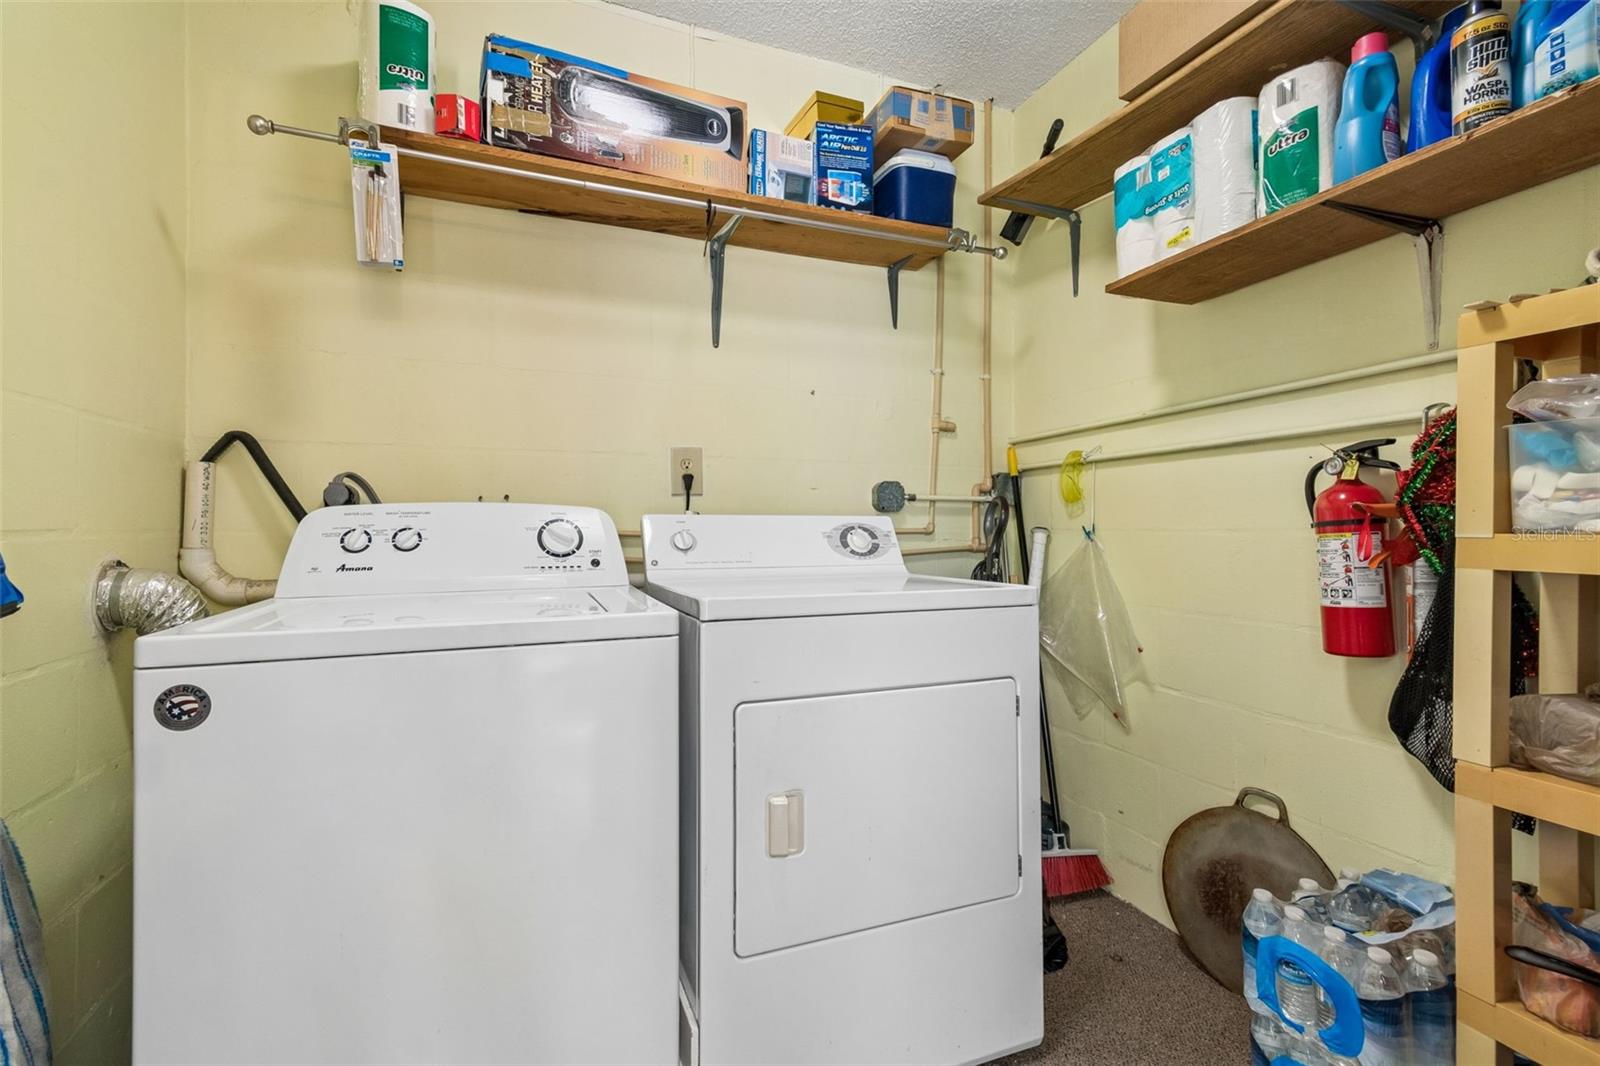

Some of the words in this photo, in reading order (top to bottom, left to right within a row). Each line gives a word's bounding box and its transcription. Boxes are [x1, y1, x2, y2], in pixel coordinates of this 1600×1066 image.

[1470, 36, 1505, 61] HOT
[1466, 47, 1508, 72] SHOT
[387, 64, 424, 81] ultra
[515, 77, 525, 109] ERAMIC
[1463, 87, 1510, 106] HORNET
[1465, 79, 1503, 96] WASP
[1502, 80, 1509, 88] &
[820, 133, 859, 144] ARCTIC
[820, 140, 842, 149] AIR
[1268, 128, 1310, 157] ultra
[1174, 182, 1190, 198] Soft
[1144, 196, 1167, 216] Strong
[335, 563, 374, 573] Amana
[158, 686, 206, 705] AMERICA
